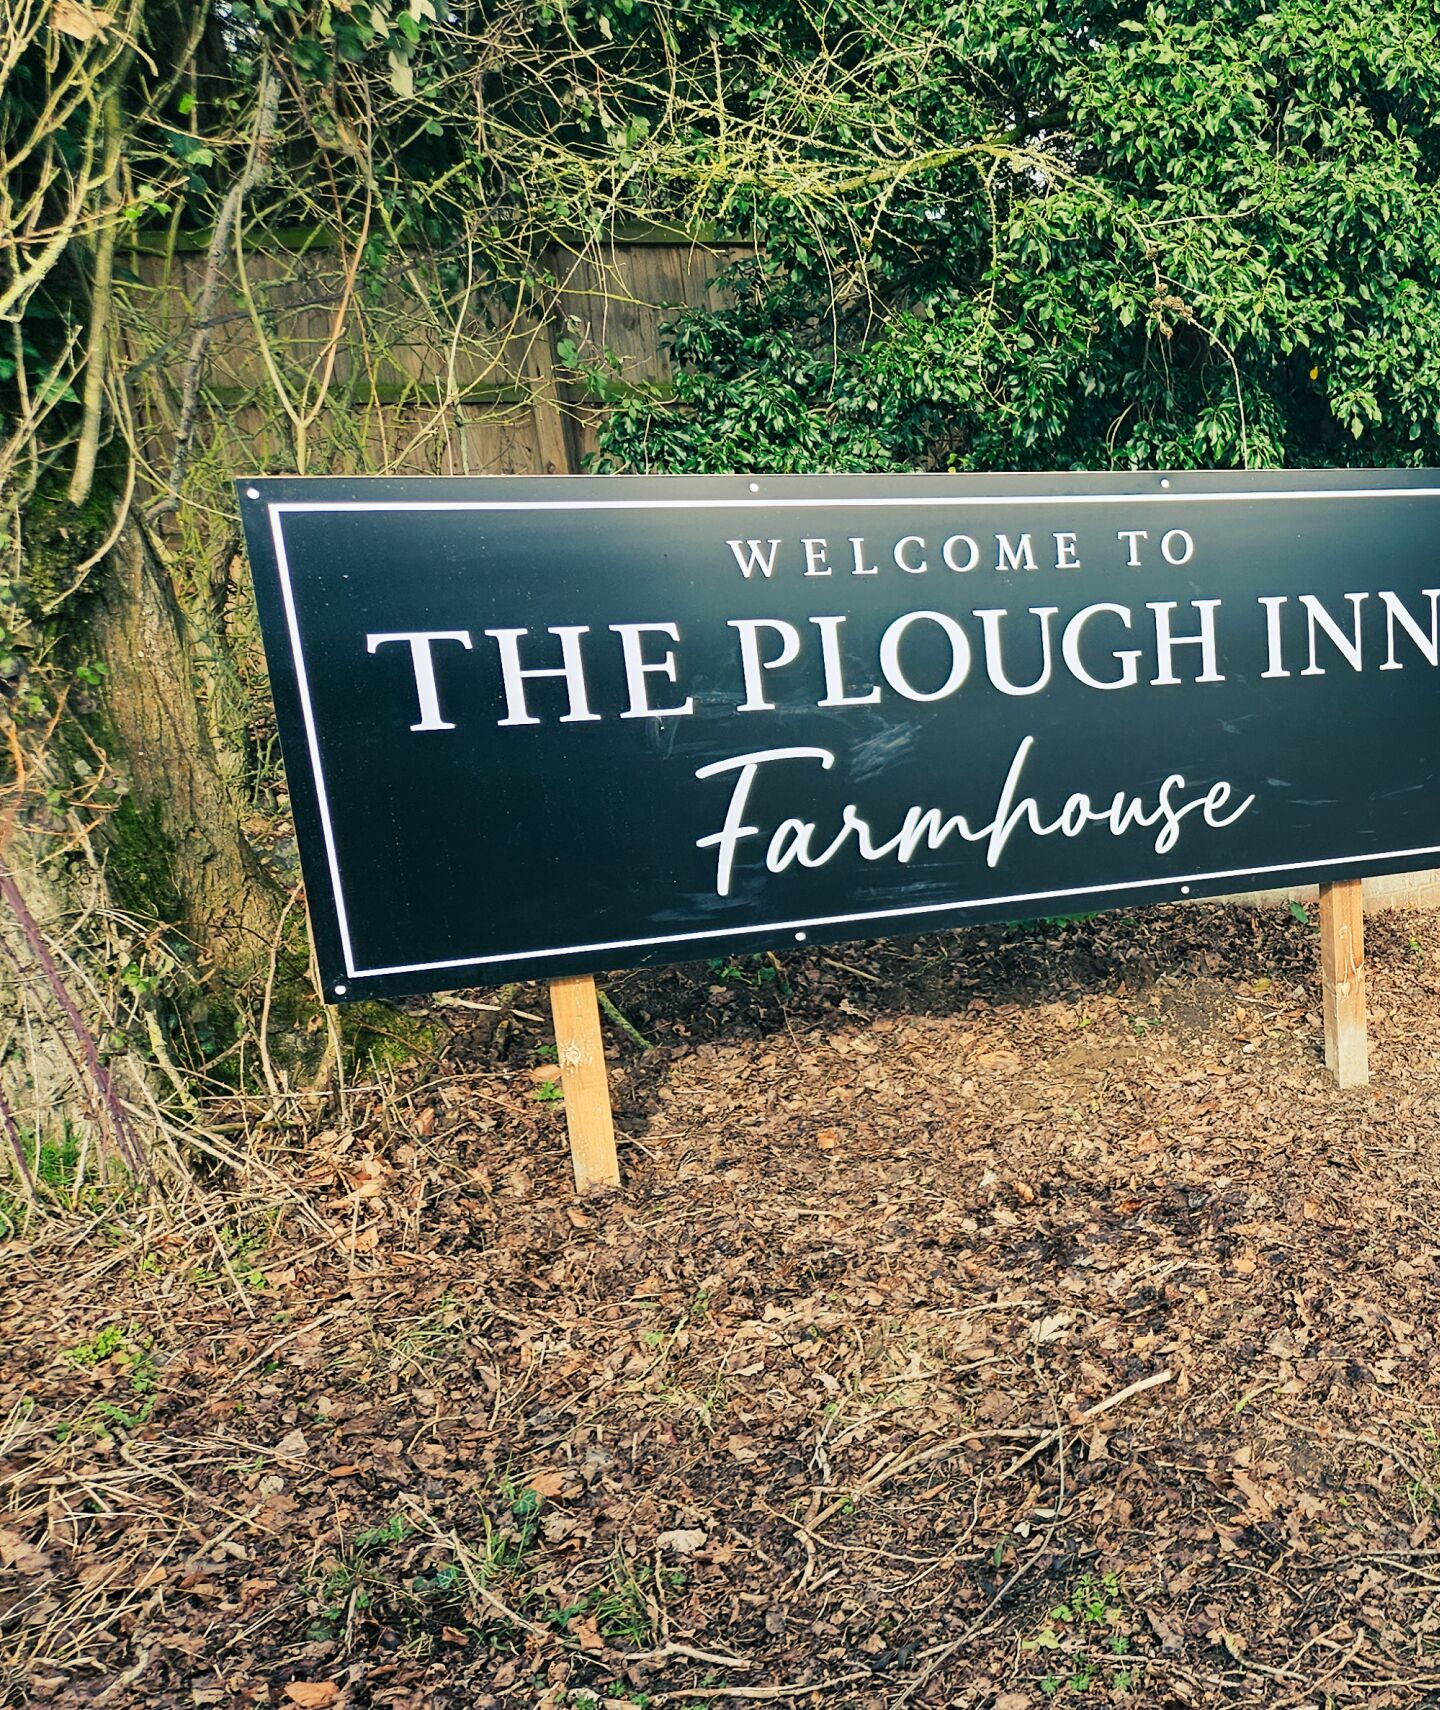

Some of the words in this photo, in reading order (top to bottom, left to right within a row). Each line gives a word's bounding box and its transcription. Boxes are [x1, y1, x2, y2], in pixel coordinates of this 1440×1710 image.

[726, 531, 1081, 579] WELCOME
[1117, 528, 1195, 567] TO
[366, 621, 694, 732] THE
[727, 598, 1226, 712] PLOUGH
[694, 735, 1256, 897] Farmhouse
